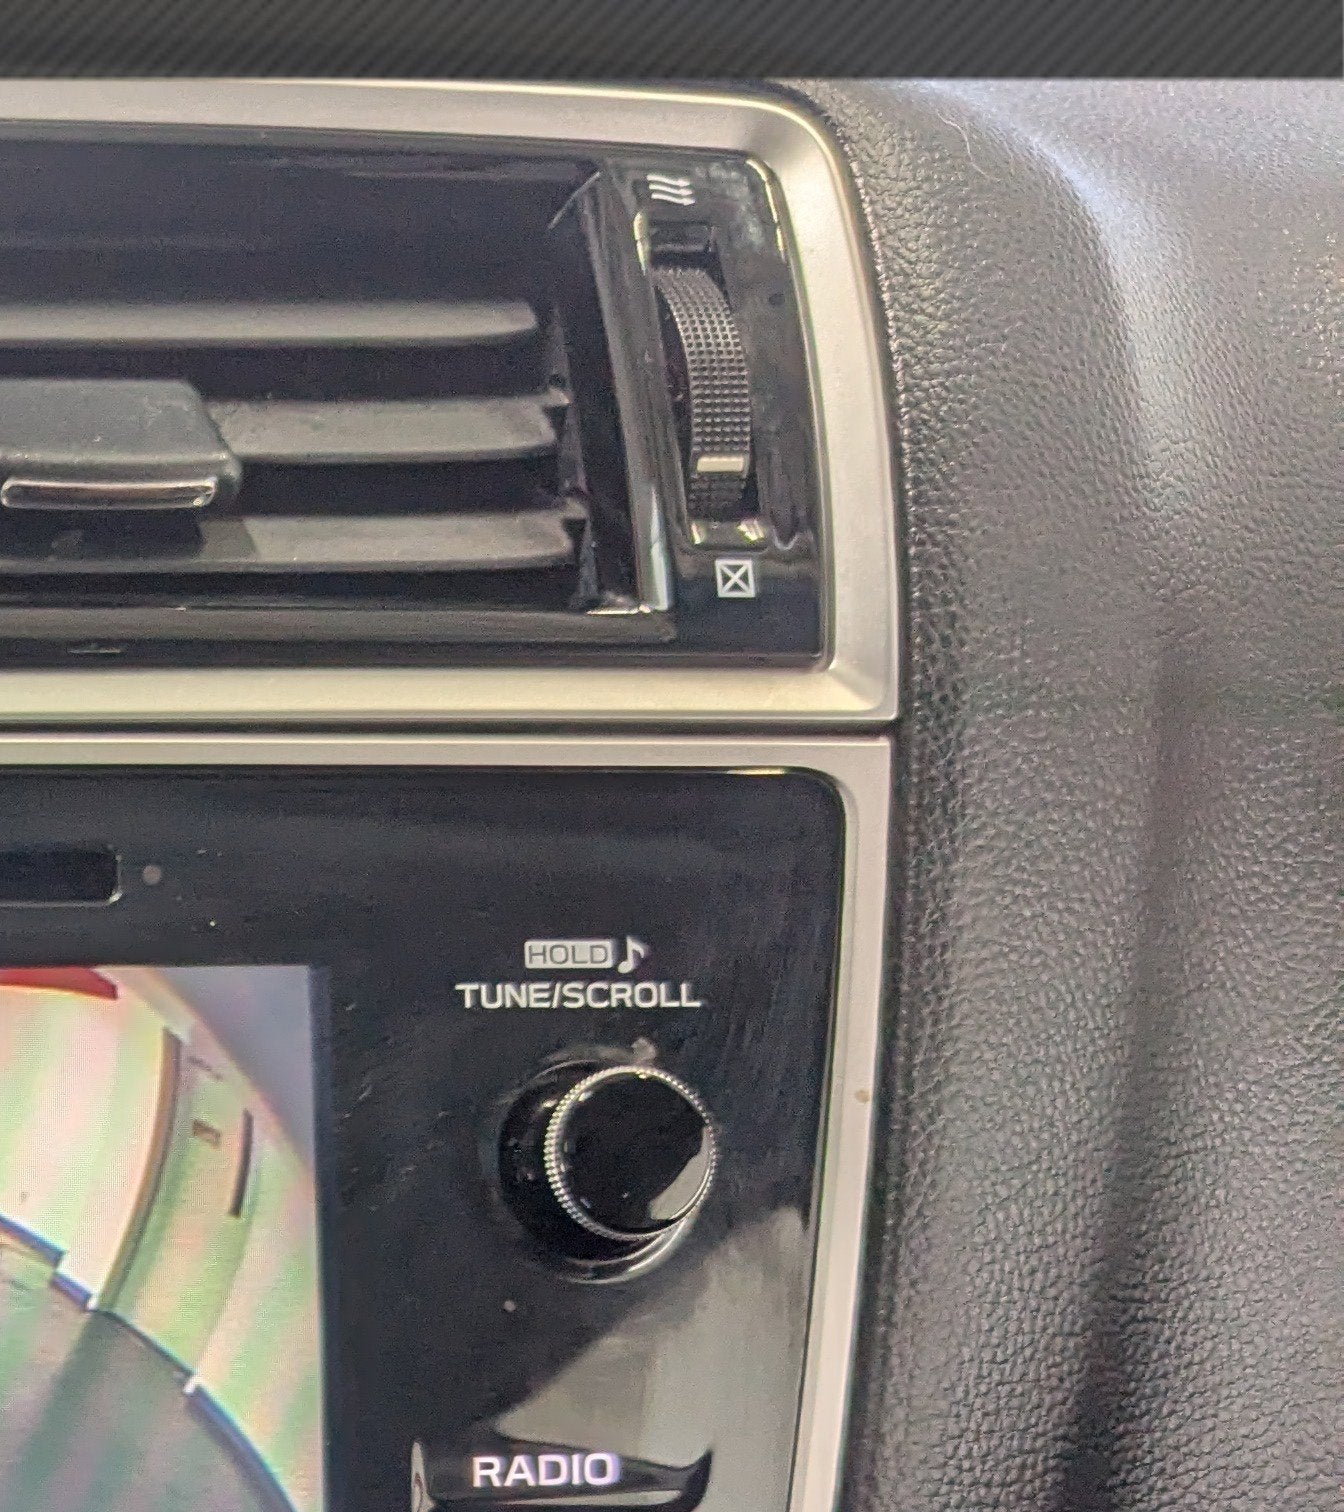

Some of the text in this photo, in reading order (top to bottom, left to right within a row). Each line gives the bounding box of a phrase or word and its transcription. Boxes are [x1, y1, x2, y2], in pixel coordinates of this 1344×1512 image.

[527, 943, 609, 966] HOLD
[455, 982, 703, 1008] TUNE/SCROLL
[472, 1453, 619, 1488] RADIO
